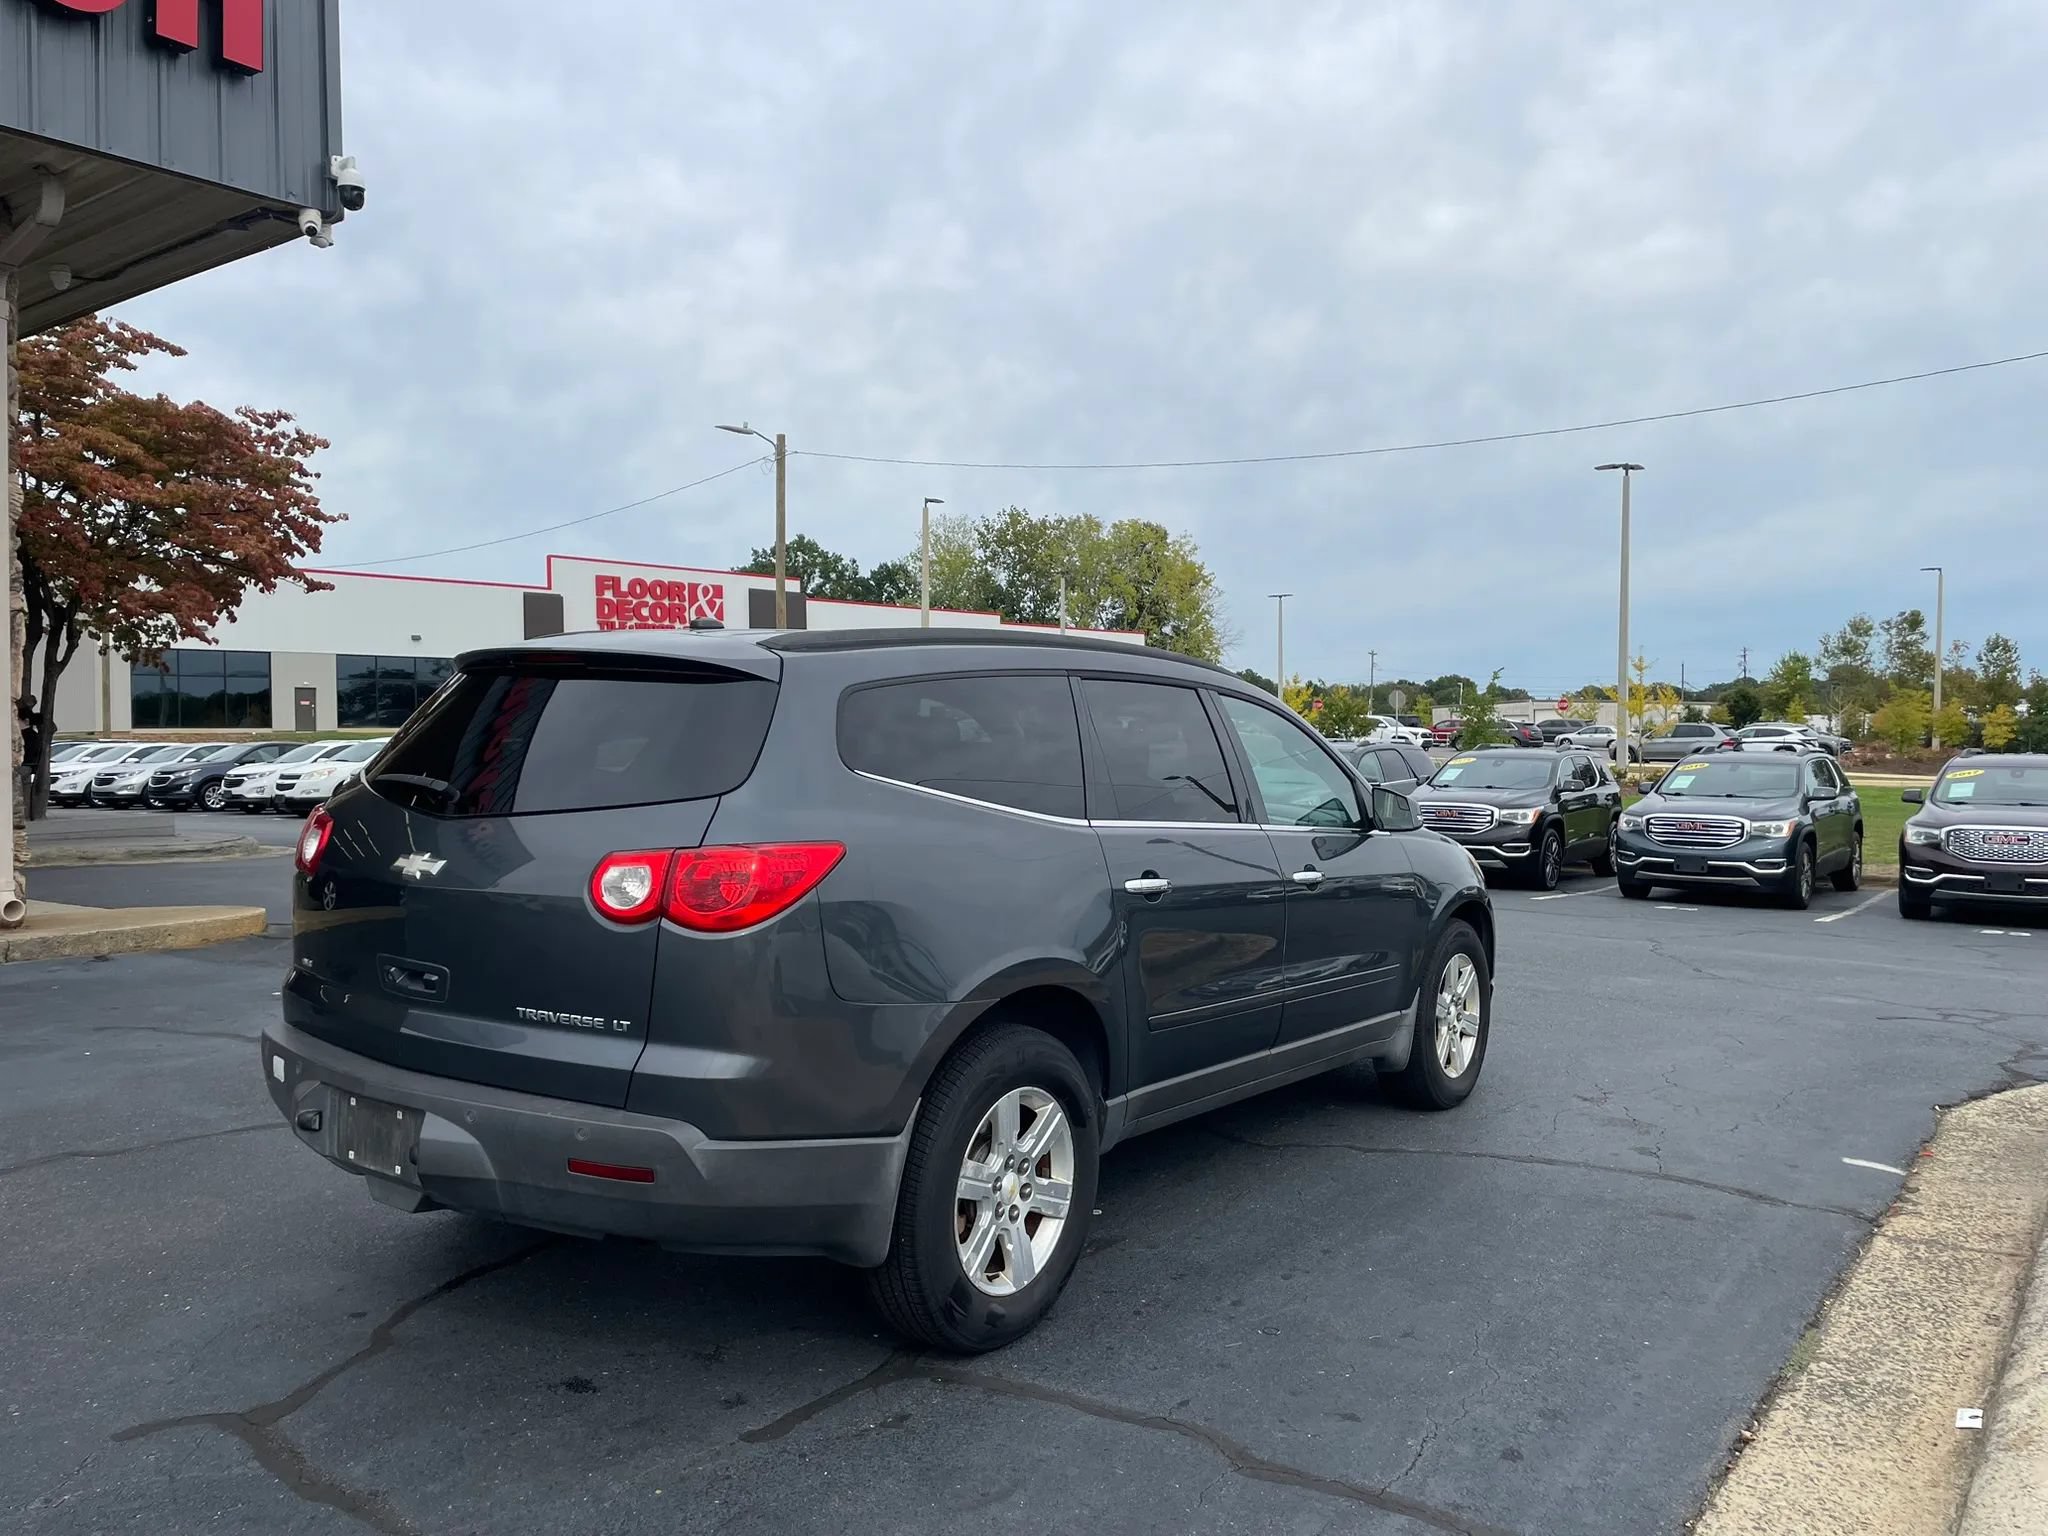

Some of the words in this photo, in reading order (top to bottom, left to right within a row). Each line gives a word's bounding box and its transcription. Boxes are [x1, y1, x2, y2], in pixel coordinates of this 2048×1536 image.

[595, 575, 687, 602] FLOOR
[596, 598, 687, 624] DECOR
[1436, 809, 1464, 818] GMC
[1677, 821, 1710, 831] GMC
[1984, 835, 2028, 844] GMC
[516, 1006, 604, 1029] TRAVERSE
[612, 1019, 631, 1032] LT
